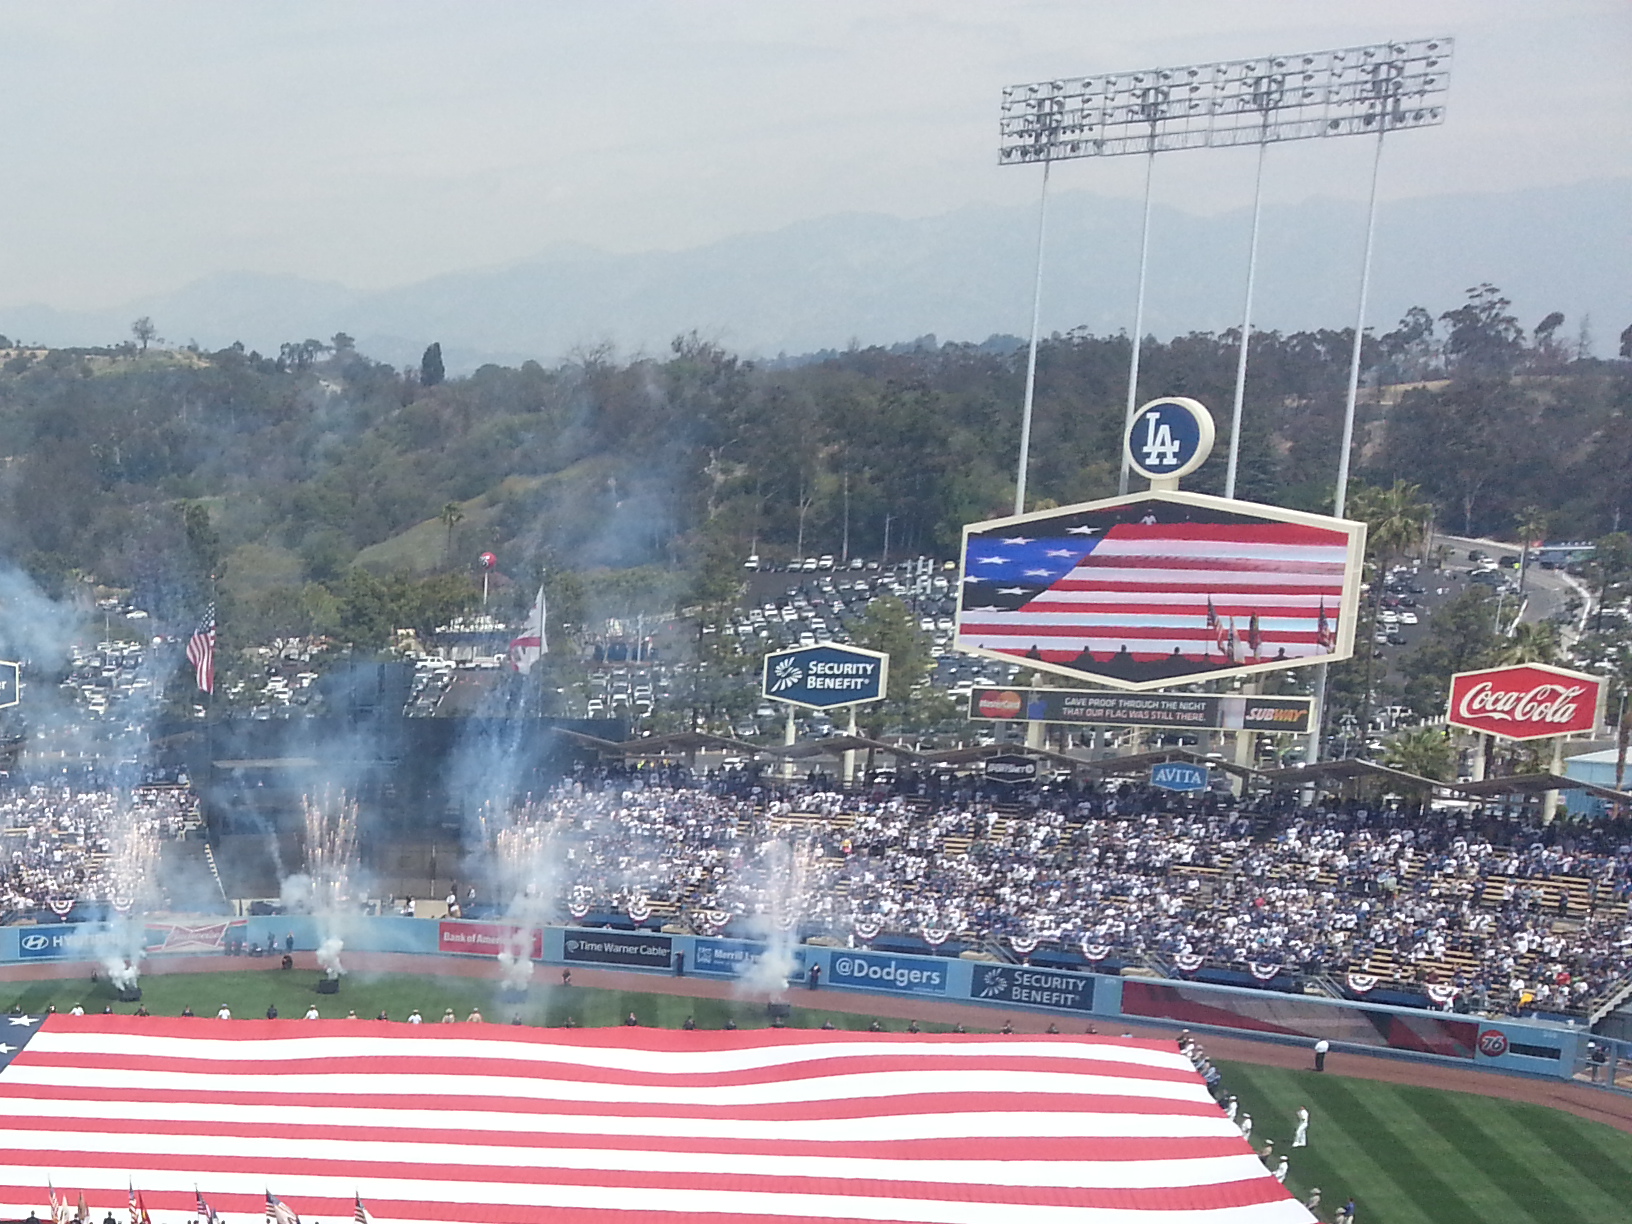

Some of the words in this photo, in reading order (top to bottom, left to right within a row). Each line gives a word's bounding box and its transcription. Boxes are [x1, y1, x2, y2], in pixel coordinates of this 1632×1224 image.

[1142, 412, 1180, 465] LA
[809, 661, 874, 675] SECURITY
[807, 676, 865, 689] BENEFIT
[1065, 697, 1087, 706] GAVE
[1088, 698, 1116, 707] PROOF
[1119, 699, 1159, 709] THROUGH
[1161, 701, 1177, 709] THE
[1179, 702, 1206, 711] NIGHT
[1460, 682, 1587, 723] Coca-Cola
[1062, 707, 1084, 715] THAT
[1085, 708, 1103, 717] OUR
[1105, 709, 1127, 718] FLAG
[1129, 710, 1149, 719] WAS
[1151, 711, 1174, 720] STILL
[1246, 707, 1308, 722] SUBWAY
[1156, 768, 1201, 784] AVITA
[443, 932, 467, 943] Bank
[467, 933, 476, 943] of
[579, 940, 603, 952] Time
[604, 942, 638, 955] Warner
[639, 945, 667, 957] Cable
[714, 949, 744, 961] Merrill
[835, 957, 941, 987] @Dodgers
[1014, 971, 1086, 991] SECURITY
[1012, 987, 1075, 1006] BENEFIT
[1482, 1036, 1504, 1050] 76
